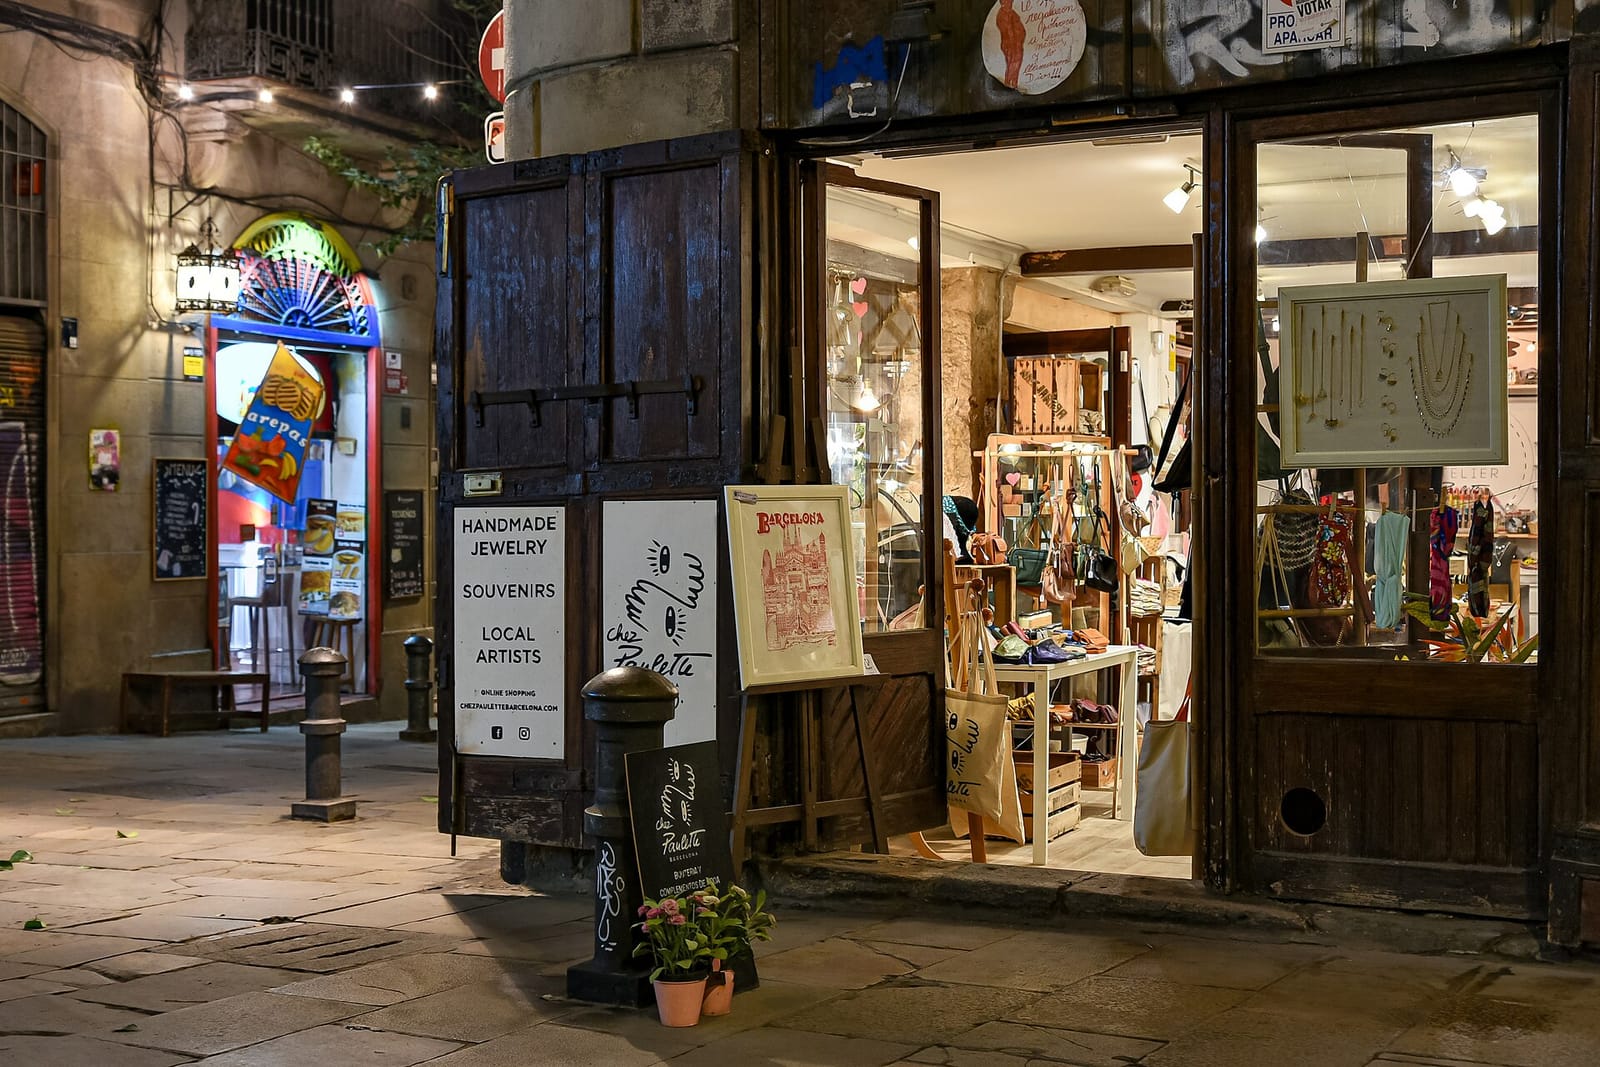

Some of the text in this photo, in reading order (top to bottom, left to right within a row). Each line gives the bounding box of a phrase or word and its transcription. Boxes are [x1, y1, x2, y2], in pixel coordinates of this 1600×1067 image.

[1297, 0, 1332, 17] VOTAR
[247, 411, 308, 448] arepas
[1450, 467, 1499, 479] ELIER
[462, 516, 557, 534] HANDMADE
[756, 512, 825, 534] BARCELONA
[471, 539, 548, 556] JEWELRY
[463, 583, 555, 599] SOUVENIRS
[482, 626, 536, 641] LOCAL
[476, 649, 542, 664] ARTISTS
[480, 689, 536, 697] ONLINE SHOPPING
[460, 703, 558, 712] CHEZPAULETTEBARCELONA.COM
[660, 881, 699, 897] COMPLEMENTOS
[698, 879, 706, 889] DE
